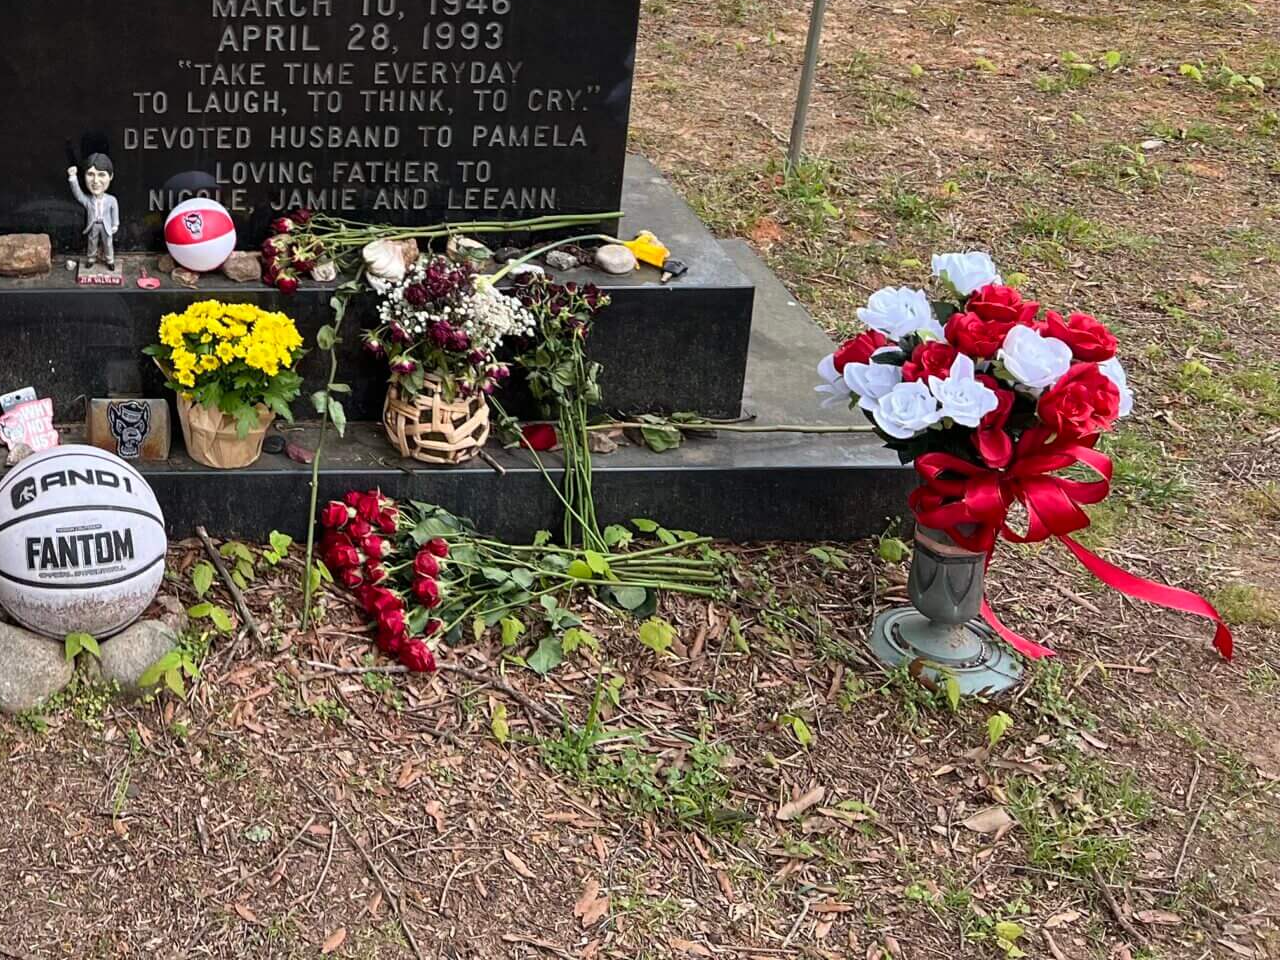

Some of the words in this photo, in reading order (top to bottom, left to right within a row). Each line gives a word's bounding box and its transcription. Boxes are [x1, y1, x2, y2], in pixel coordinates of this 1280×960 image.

[218, 24, 320, 52] APRIL
[348, 23, 399, 54] 28,
[422, 22, 504, 50] 1993
[284, 63, 353, 85] TIME
[374, 62, 523, 84] EVERYDAY
[133, 92, 167, 113] TO
[187, 92, 287, 116] LAUGH,
[307, 92, 341, 113] TO
[360, 91, 453, 116] THINK,
[473, 90, 507, 112] TO
[123, 127, 250, 150] DEVOTED
[269, 126, 399, 148] HUSBAND
[417, 126, 451, 147] TO
[472, 125, 587, 147] PAMELA
[215, 161, 313, 184] LOVING
[332, 161, 439, 183] FATHER
[457, 161, 492, 182] TO
[270, 188, 354, 211] JAMIE
[373, 188, 428, 211] AND
[447, 187, 557, 210] LEEANN
[20, 399, 52, 419] WHY
[26, 527, 135, 570] FANTOM
